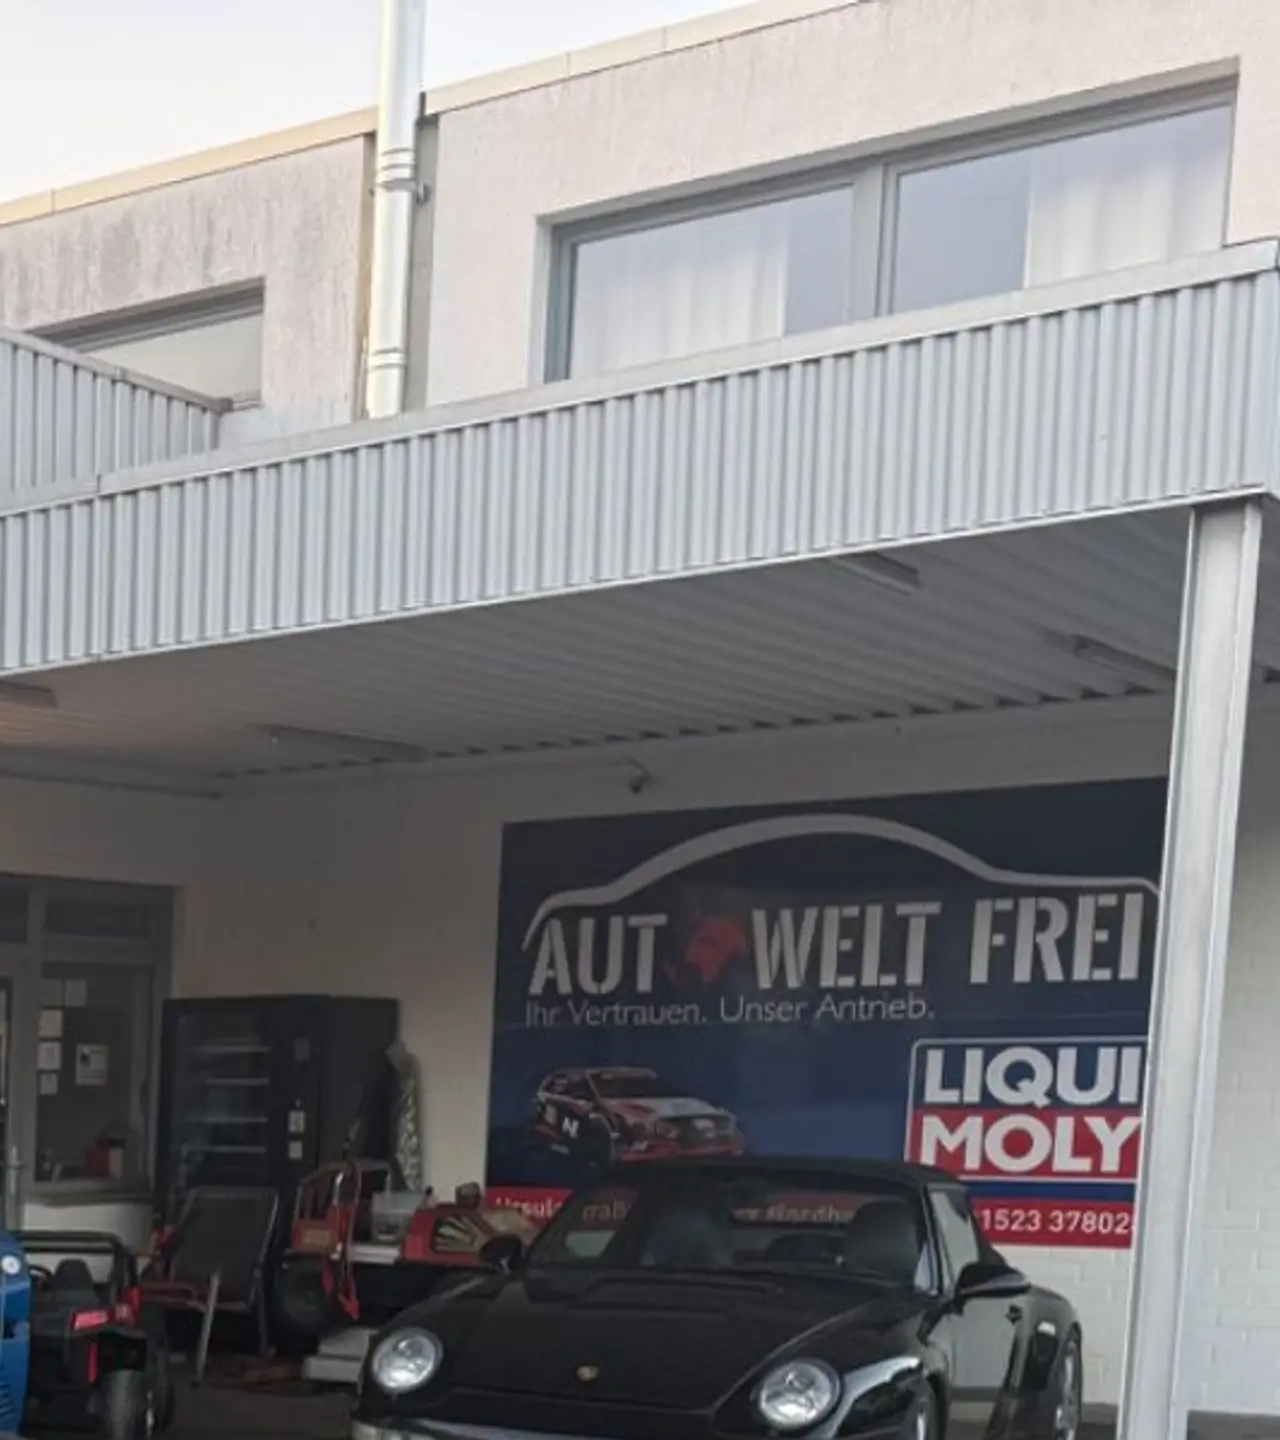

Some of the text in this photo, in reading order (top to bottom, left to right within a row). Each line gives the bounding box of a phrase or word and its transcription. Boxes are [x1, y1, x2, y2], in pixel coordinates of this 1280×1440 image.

[970, 893, 1144, 983] FREI
[526, 993, 935, 1027] Ihr Vertrauen. Unser Antrieb.
[924, 1046, 1141, 1108] LIQUI
[921, 1113, 1142, 1174] MOLY
[1048, 1210, 1136, 1235] 37802
